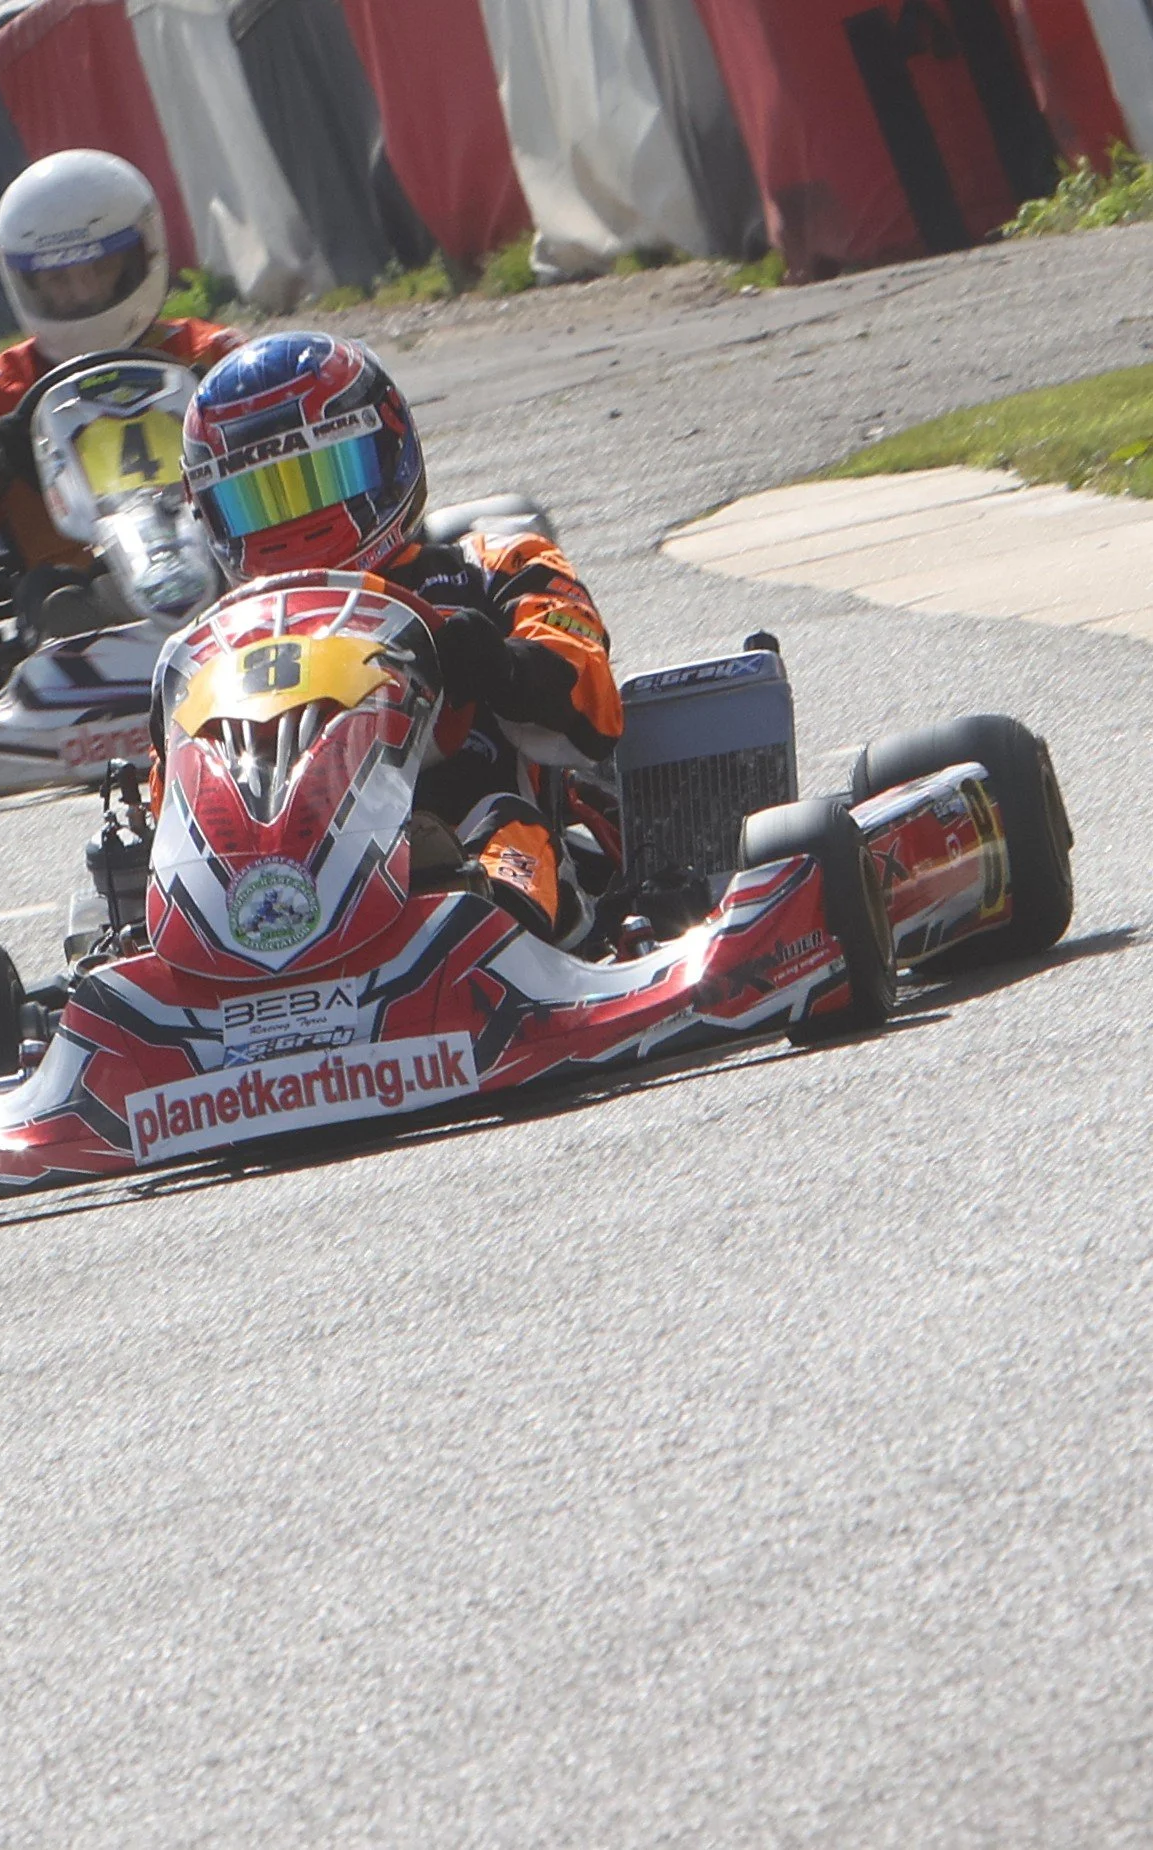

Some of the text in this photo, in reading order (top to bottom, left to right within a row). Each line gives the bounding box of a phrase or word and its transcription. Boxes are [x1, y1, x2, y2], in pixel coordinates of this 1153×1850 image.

[120, 422, 163, 481] 4
[242, 642, 303, 694] 8
[224, 986, 354, 1029] BEBA
[134, 1040, 471, 1158] planetkarting.uk
